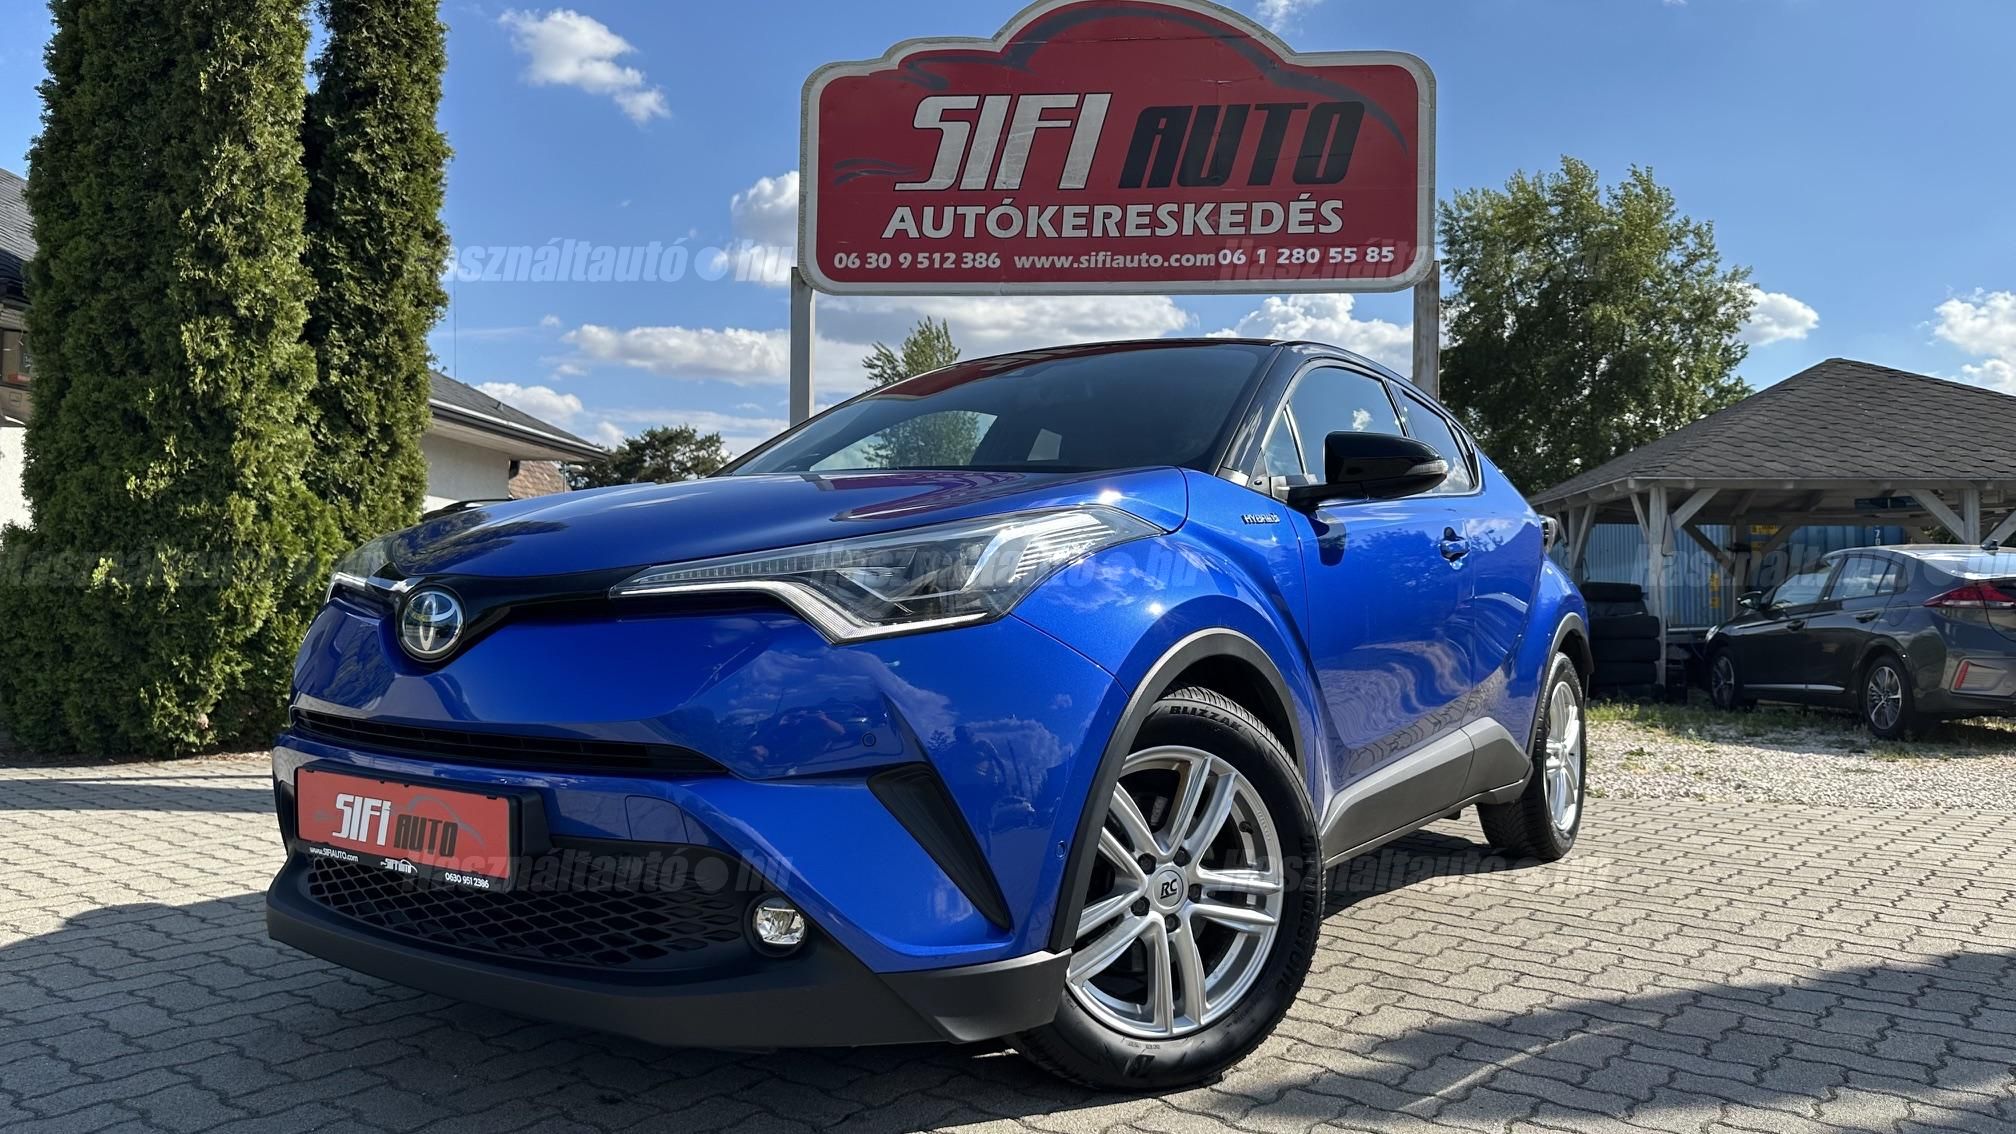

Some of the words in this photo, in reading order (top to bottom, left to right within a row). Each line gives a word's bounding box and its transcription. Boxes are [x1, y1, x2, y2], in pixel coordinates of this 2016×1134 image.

[893, 92, 1112, 191] SIFI
[1118, 101, 1365, 189] AUTO
[880, 193, 1344, 240] AUTÓKERESKEDÉS
[833, 253, 861, 269] 06
[865, 253, 891, 269] 30
[898, 253, 912, 269] 9
[917, 253, 956, 269] 512
[961, 252, 1001, 269] 386
[1014, 251, 1215, 269] www.sifiauto.com
[1218, 249, 1247, 265] 06
[1257, 249, 1266, 264] 1
[1276, 248, 1321, 264] 280
[1329, 248, 1357, 263] 55
[1365, 247, 1395, 263] 85
[1169, 706, 1243, 733] BLIZZAK
[394, 814, 458, 857] AUTO
[1160, 878, 1178, 899] RC
